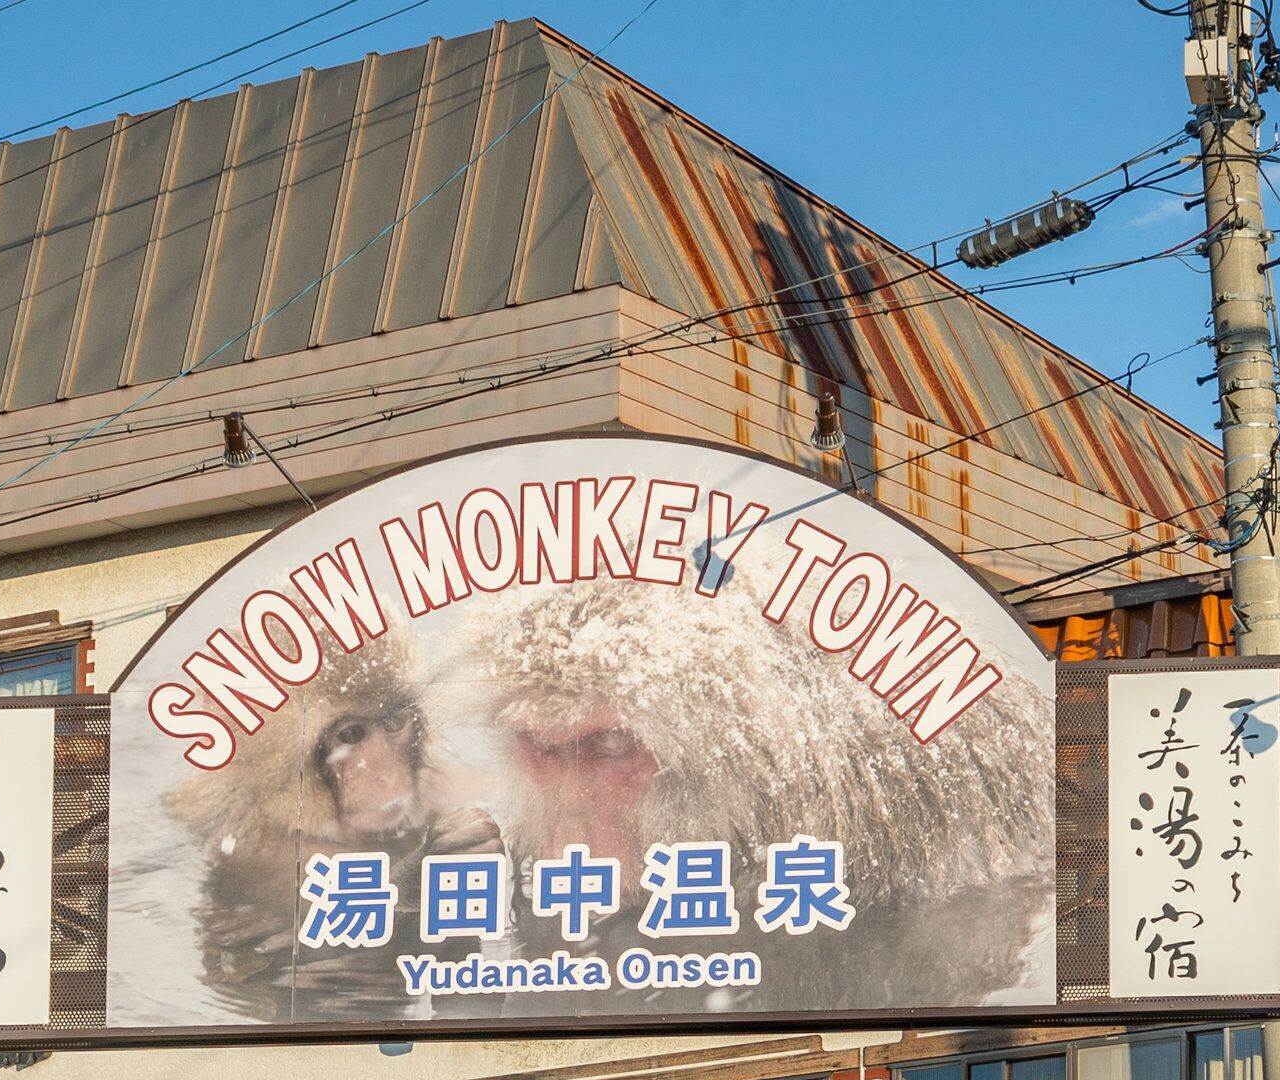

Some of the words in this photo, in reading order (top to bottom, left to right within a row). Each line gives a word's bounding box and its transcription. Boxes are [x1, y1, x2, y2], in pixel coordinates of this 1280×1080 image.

[148, 537, 390, 770] SNOW
[381, 476, 769, 618] MONKEY
[763, 519, 1004, 747] TOWN
[301, 836, 854, 947] 湯田中温泉
[1130, 687, 1205, 981] 美湯の宿
[403, 953, 606, 996] Yudanaka
[621, 950, 761, 992] Onsen
